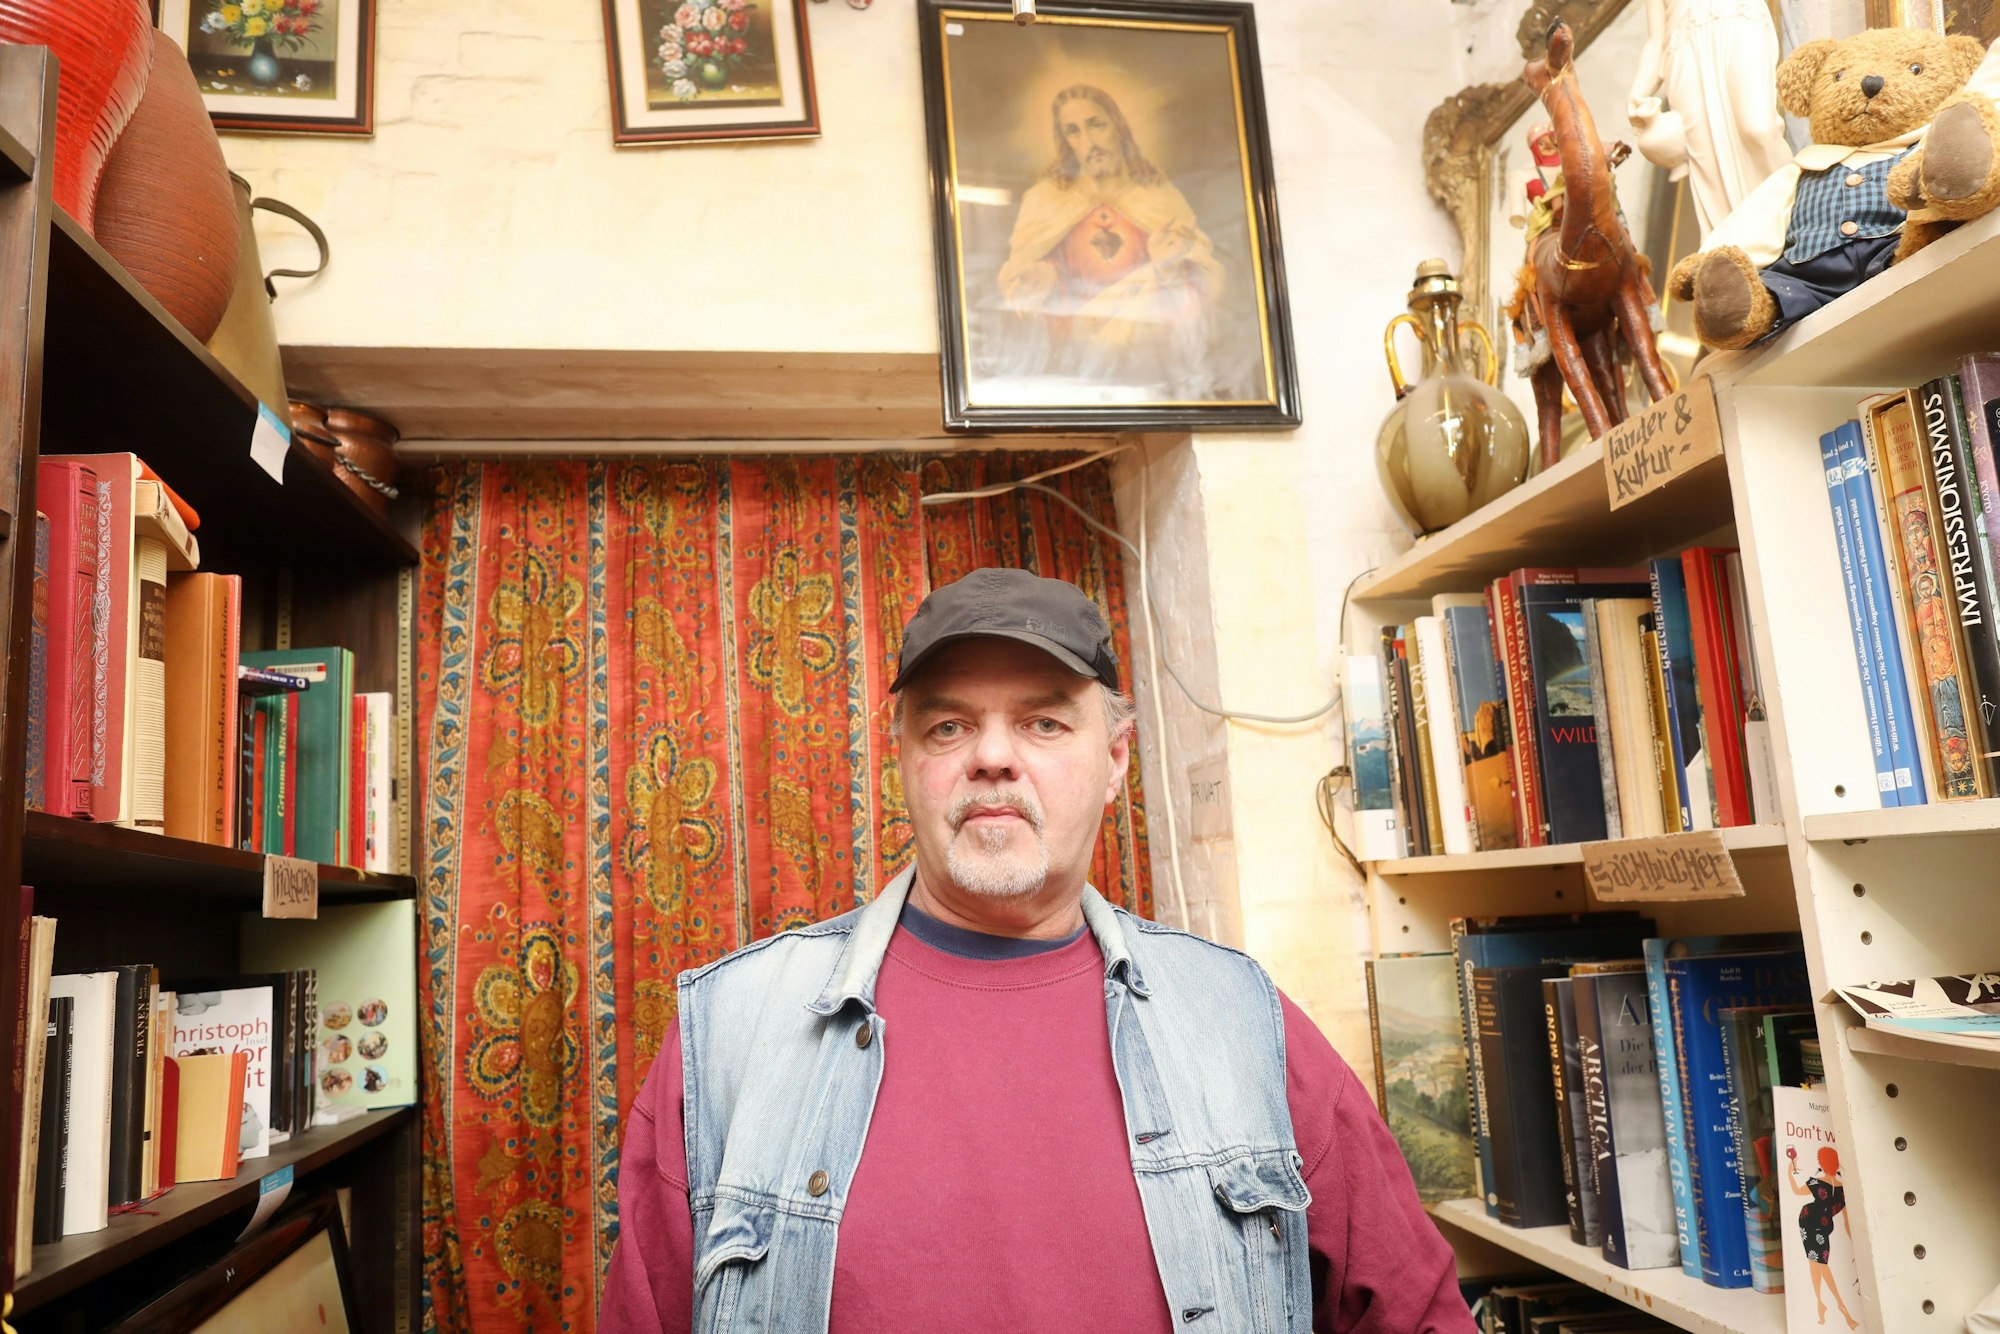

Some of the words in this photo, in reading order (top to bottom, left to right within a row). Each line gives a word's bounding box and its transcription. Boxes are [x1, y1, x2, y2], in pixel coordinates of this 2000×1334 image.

[1674, 393, 1693, 436] &
[1836, 505, 1844, 525] Brühl
[1851, 498, 1859, 518] Brühl
[1924, 393, 1982, 627] IMPRESSIONISMUS
[1980, 479, 1993, 514] KYOTO
[1840, 525, 1845, 534] in
[1855, 518, 1861, 526] in
[1501, 594, 1510, 616] DIE
[1650, 572, 1671, 669] GRIECHENLAND
[220, 596, 229, 657] Fontaine
[1513, 598, 1530, 682] KANADA
[1874, 626, 1884, 661] Schlösser
[1504, 623, 1523, 708] ACCADEMIA
[1858, 632, 1868, 666] Schlösser
[219, 660, 227, 680] La
[1409, 664, 1427, 728] ROM
[1867, 684, 1878, 724] Hansmann
[1883, 680, 1894, 720] Hansmann
[217, 713, 226, 761] Fabeln
[278, 698, 288, 758] Märchen
[1515, 711, 1525, 727] IN
[1890, 719, 1900, 752] Wilfried
[1874, 723, 1883, 755] Wilfried
[217, 761, 225, 791] Die
[1518, 731, 1533, 798] VENEDIG
[276, 760, 286, 817] Grimms
[136, 1002, 145, 1057] TRÄNEN
[1464, 960, 1480, 1039] Geschichte
[1472, 1041, 1484, 1067] der
[1545, 1002, 1558, 1058] MOND
[247, 1036, 268, 1046] Insel
[1620, 1039, 1644, 1053] Die
[1553, 1063, 1564, 1101] DER
[1622, 1061, 1644, 1074] der
[62, 1099, 70, 1135] Gedichte
[1585, 1035, 1612, 1161] ARCTICA
[1808, 1101, 1830, 1113] Margit
[1786, 1121, 1822, 1141] Don't
[1729, 1096, 1750, 1217] Musikinstrumente
[1676, 1206, 1690, 1246] DER
[1697, 1215, 1710, 1259] DAS
